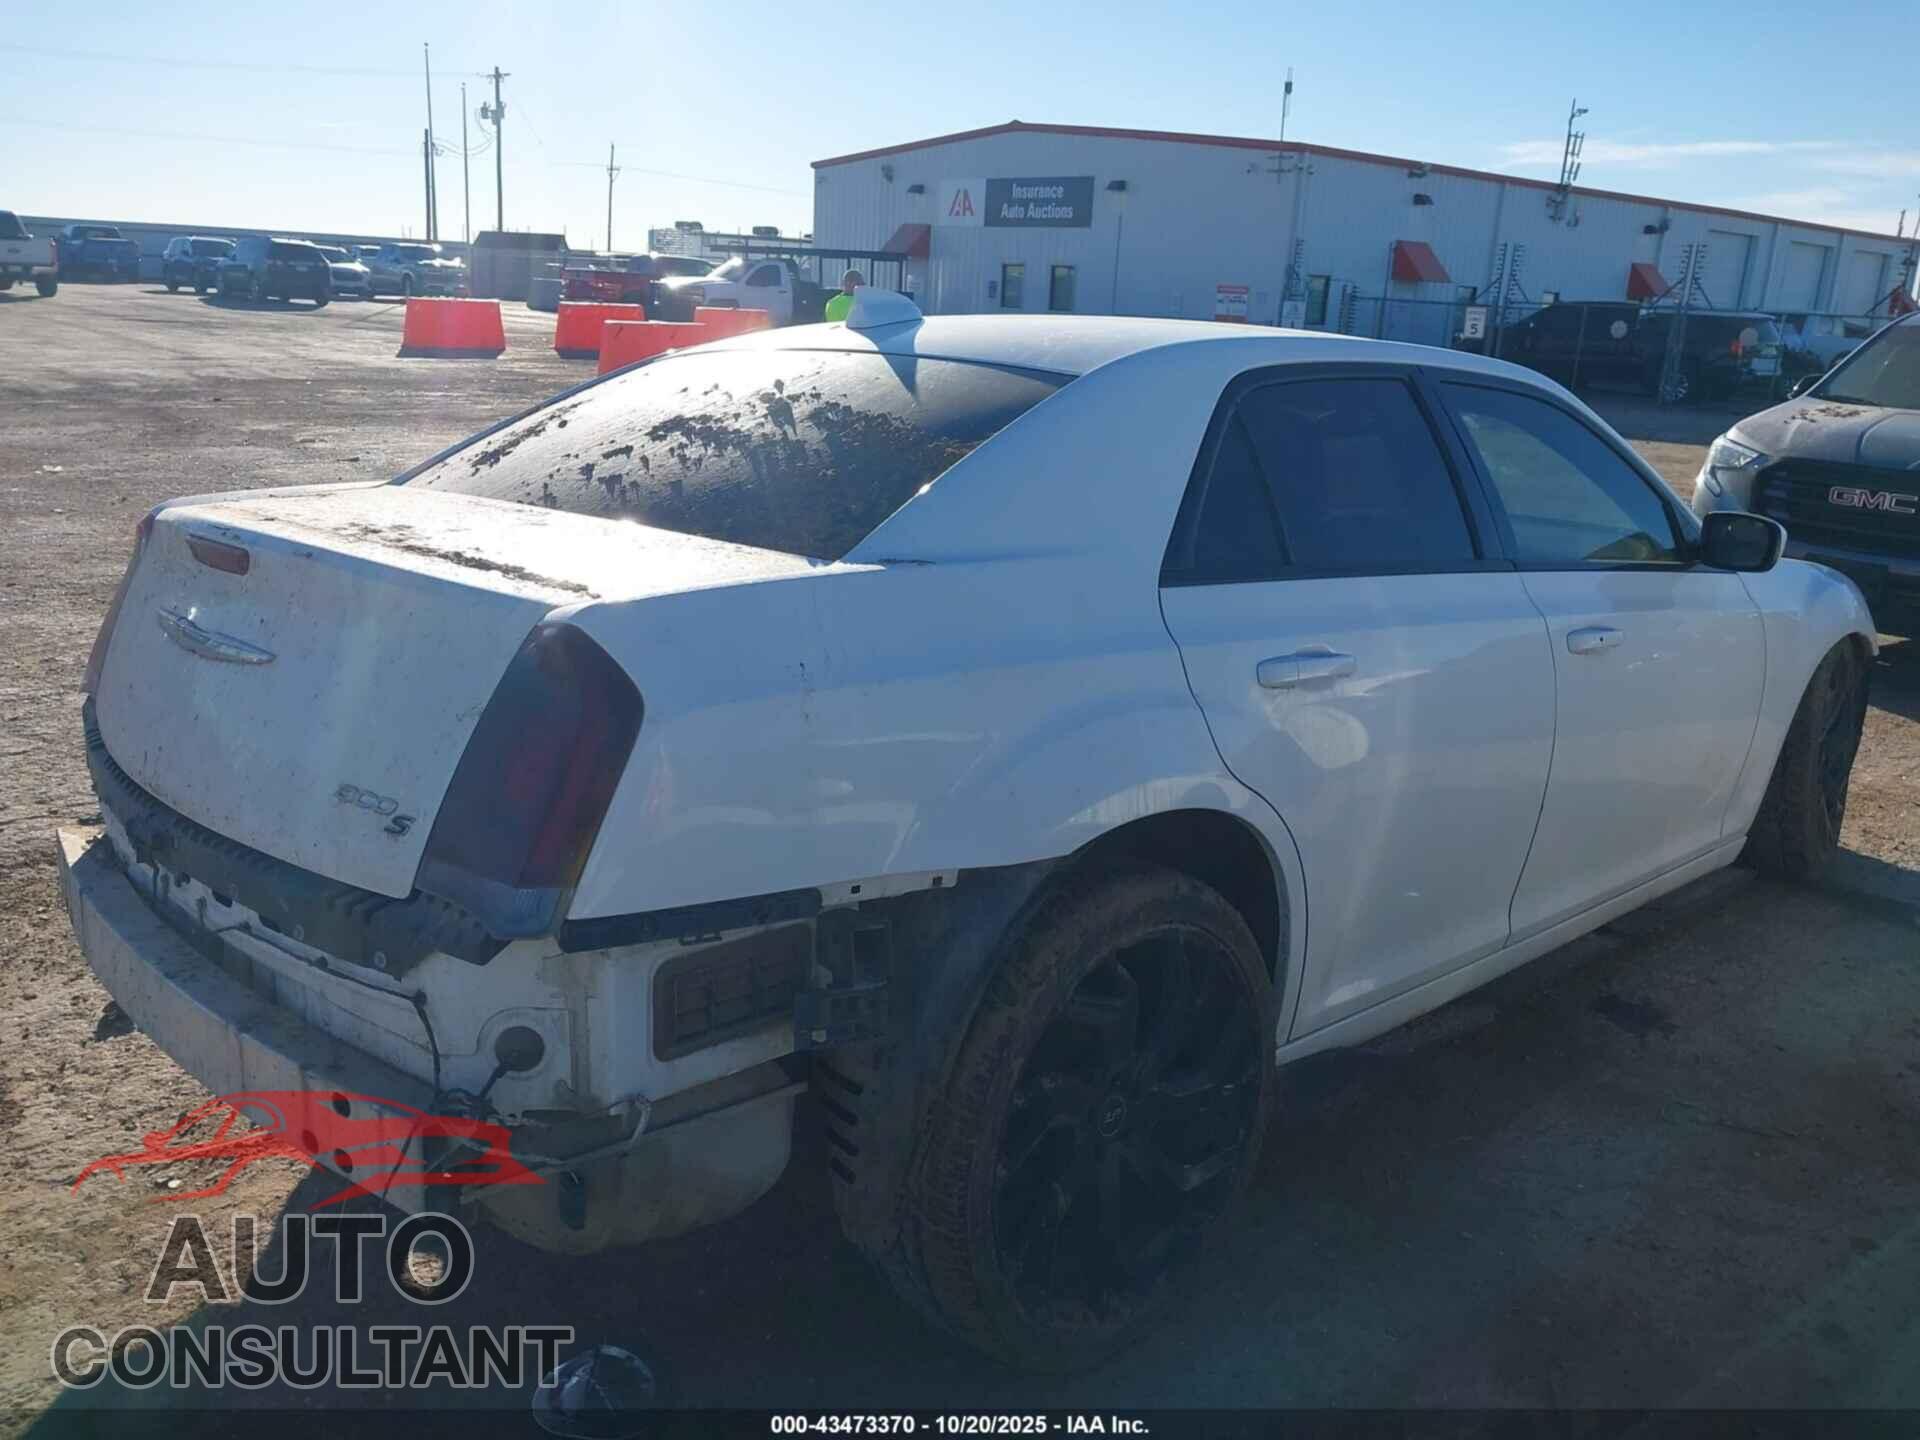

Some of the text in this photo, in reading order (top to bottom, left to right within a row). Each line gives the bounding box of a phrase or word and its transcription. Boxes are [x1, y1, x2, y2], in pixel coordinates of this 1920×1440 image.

[1011, 183, 1065, 200] Insurance
[1000, 201, 1073, 219] Auto Auctions
[1470, 323, 1478, 335] 5
[1828, 486, 1919, 514] GMC
